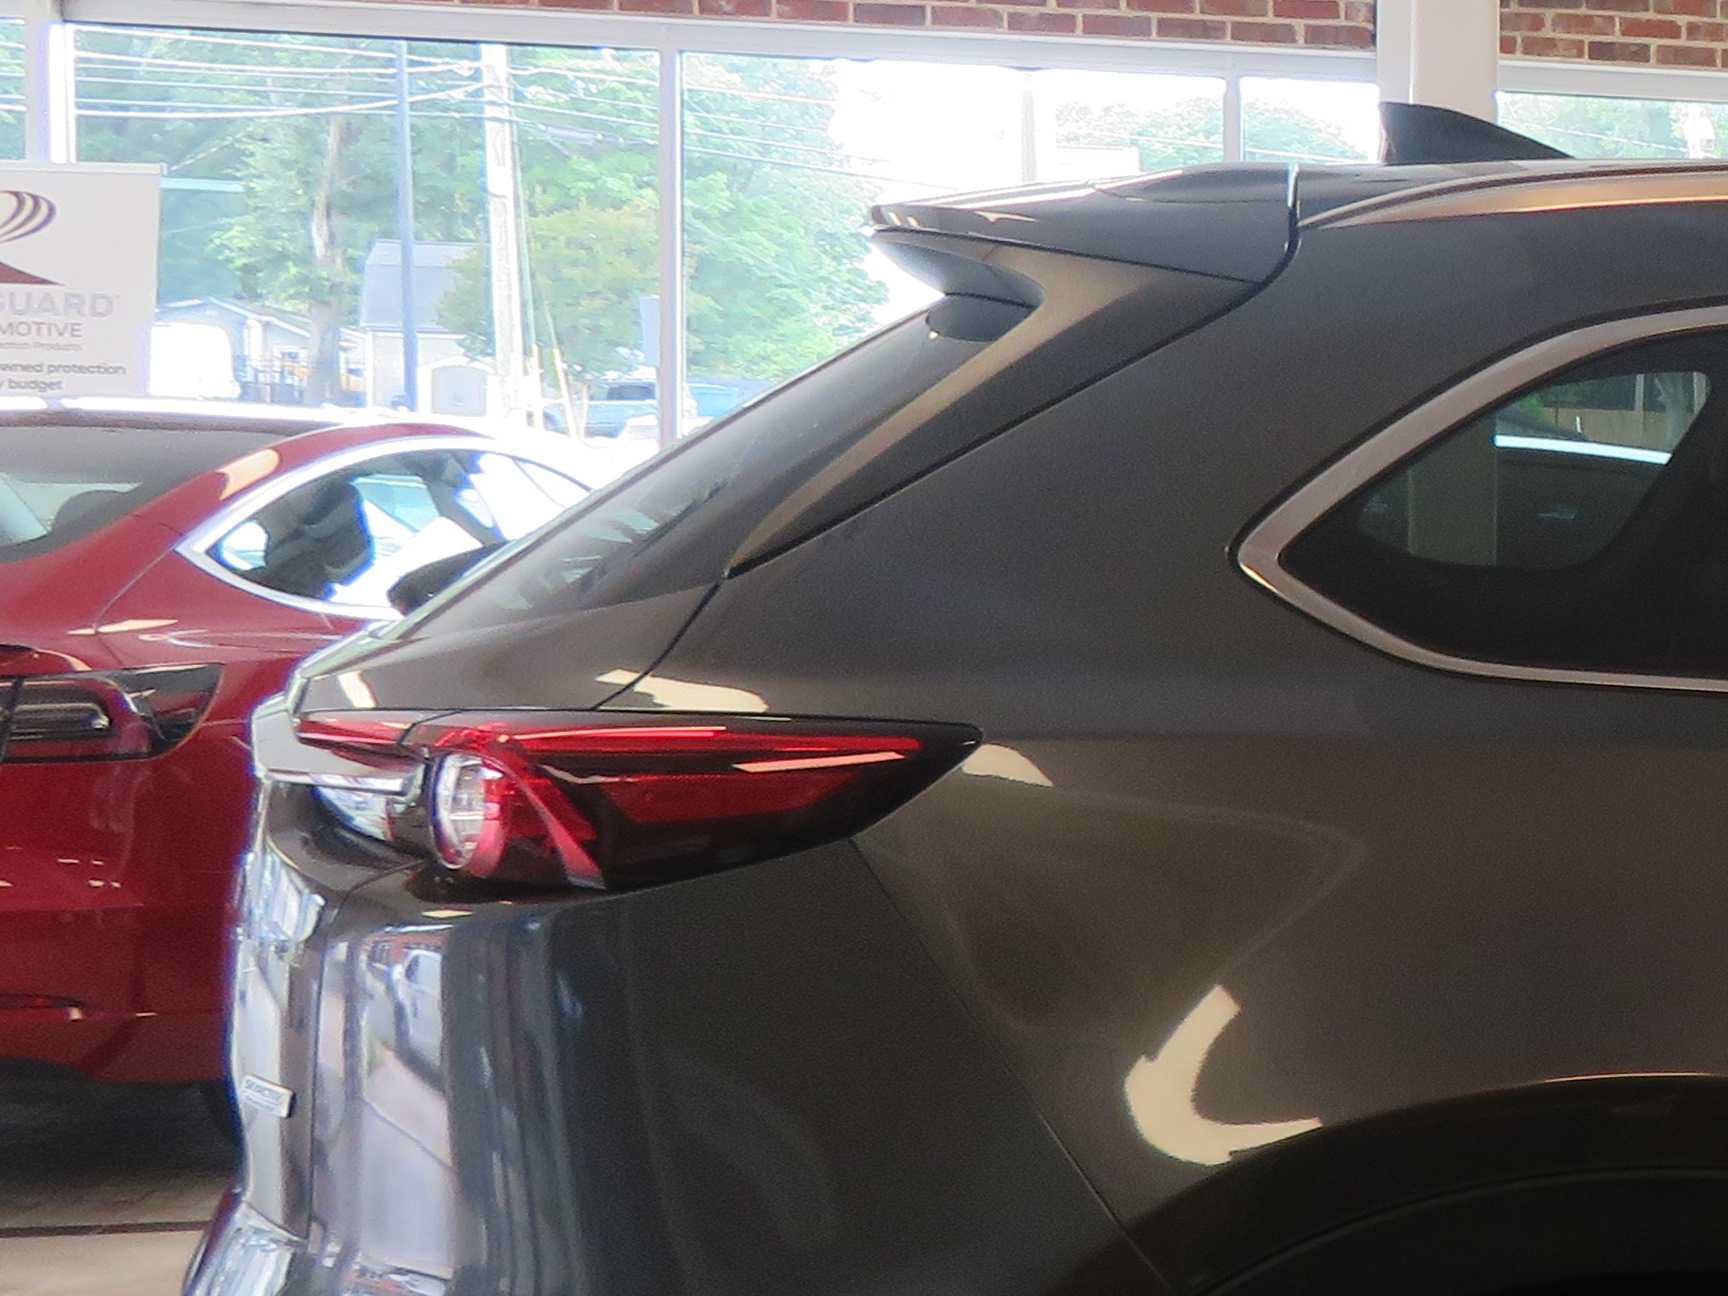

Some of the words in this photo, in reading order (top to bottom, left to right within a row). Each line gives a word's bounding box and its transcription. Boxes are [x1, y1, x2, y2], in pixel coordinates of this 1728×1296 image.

[0, 292, 113, 317] UARD
[47, 363, 127, 375] protection
[8, 378, 63, 392] budget
